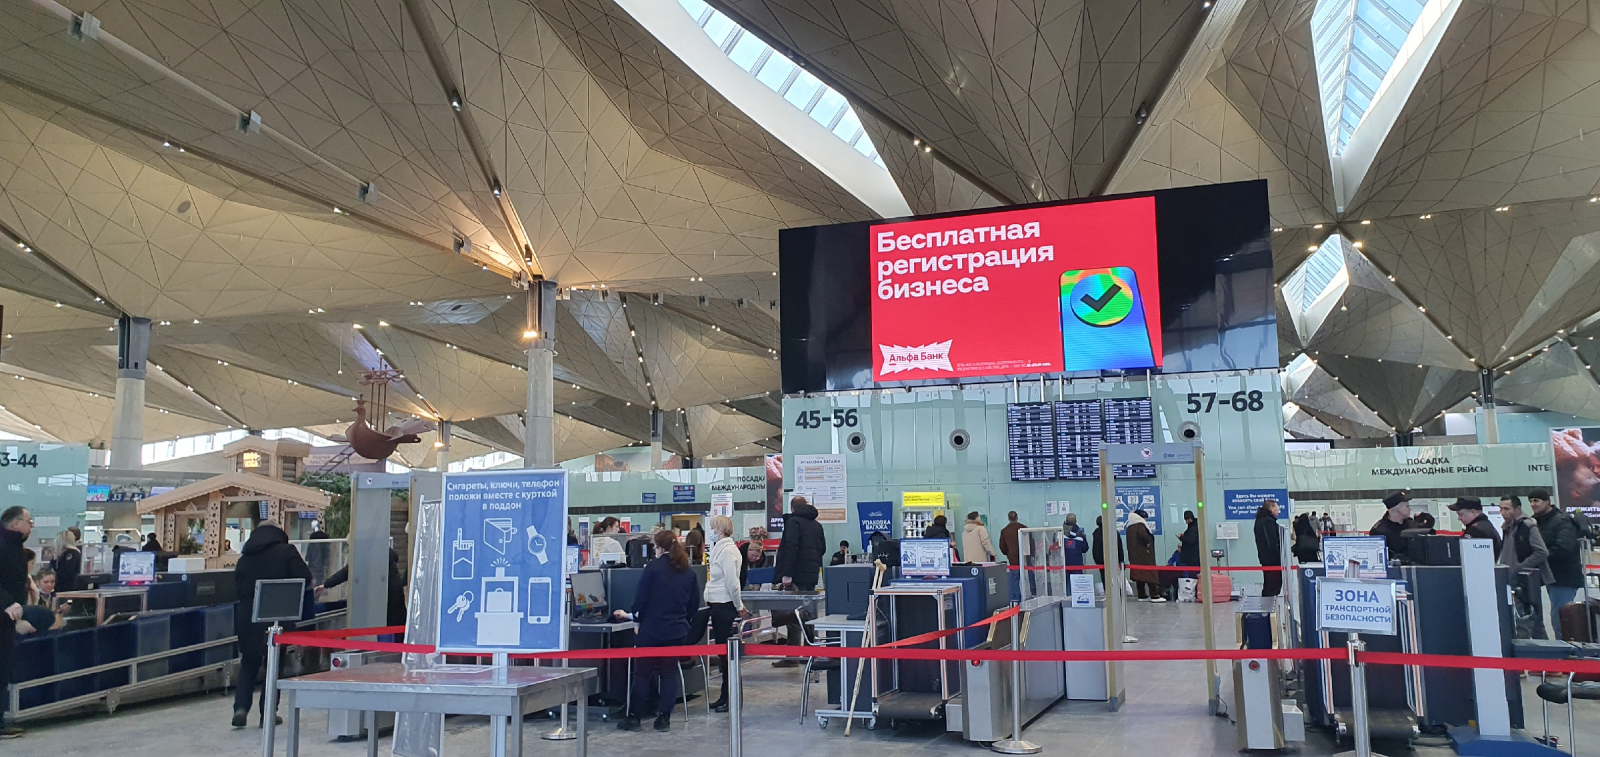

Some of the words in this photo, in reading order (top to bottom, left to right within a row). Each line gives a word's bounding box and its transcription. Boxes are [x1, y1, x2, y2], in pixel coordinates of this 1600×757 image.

[877, 221, 1040, 252] Бесплатная
[877, 245, 1054, 282] регистрация
[877, 276, 990, 300] бизнеса
[889, 353, 919, 364] Альфа
[920, 352, 944, 361] Банк
[1187, 390, 1264, 414] 57-68
[795, 408, 858, 429] 45-56
[0, 452, 38, 468] 3-44
[1371, 466, 1454, 476] МЕЖДУНАРОДНЫЕ
[1456, 465, 1488, 473] РЕЙСЫ
[447, 482, 489, 491] Сигареты,
[490, 481, 520, 489] ключи,
[522, 479, 560, 489] телефон
[521, 488, 558, 500] курткой
[489, 502, 522, 510] поддон
[1334, 590, 1380, 604] ЗОНА
[1325, 604, 1391, 614] ТРАНСПОРТНОЙ
[1325, 614, 1391, 623] БЕЗОПАСНОСТИ
